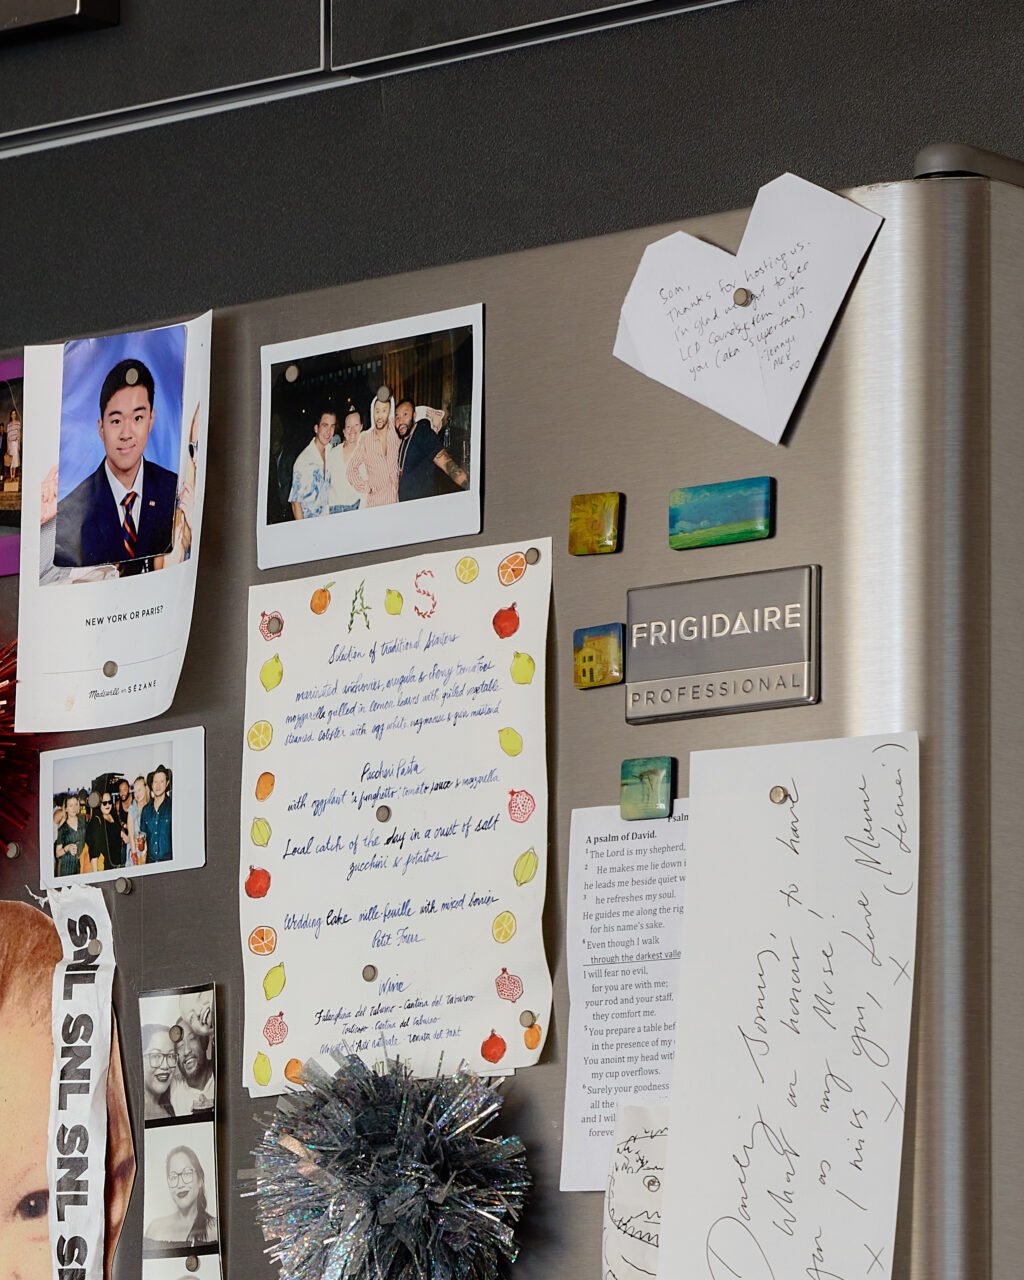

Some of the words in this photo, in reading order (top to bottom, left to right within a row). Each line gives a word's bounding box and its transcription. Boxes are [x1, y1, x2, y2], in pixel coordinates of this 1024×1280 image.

[667, 292, 712, 322] Thanks
[718, 279, 737, 294] for
[745, 253, 788, 282] hosting
[694, 308, 719, 336] glad
[750, 285, 766, 311] got
[774, 276, 786, 288] to
[348, 578, 372, 633] A
[414, 569, 437, 619] S
[85, 617, 104, 626] NEW
[107, 613, 127, 623] YORK
[130, 611, 140, 620] OR
[142, 605, 164, 618] PARIS?
[631, 603, 801, 648] FRIGIDAIRE
[631, 673, 801, 709] PROFESSIONAL
[287, 792, 308, 811] with
[283, 836, 314, 860] Local
[316, 834, 345, 853] catch
[349, 834, 359, 855] of
[363, 828, 380, 848] the
[384, 826, 406, 850] day
[410, 828, 420, 841] in
[434, 819, 460, 839] crust
[462, 816, 473, 838] of
[475, 813, 500, 832] salt
[586, 836, 592, 844] A
[593, 833, 619, 845] psalm
[621, 832, 630, 841] of
[631, 830, 657, 841] David.
[590, 850, 605, 859] The
[606, 848, 625, 858] Lord
[626, 847, 633, 856] is
[635, 847, 647, 857] my
[648, 843, 686, 856] shepherd,
[346, 853, 388, 881] zucchini
[402, 848, 448, 876] potatoes
[597, 865, 608, 874] He
[609, 863, 635, 873] makes
[636, 863, 649, 871] me
[650, 861, 660, 870] lie
[660, 859, 682, 869] down
[584, 881, 594, 890] he
[595, 879, 616, 889] leads
[617, 879, 630, 887] me
[631, 875, 657, 886] beside
[658, 874, 677, 886] quiet
[595, 895, 605, 905] he
[606, 892, 644, 904] refreshes
[645, 893, 657, 902] my
[658, 890, 676, 899] soul.
[779, 883, 802, 907] to
[583, 911, 593, 920] He
[594, 909, 621, 921] guides
[622, 909, 635, 917] me
[636, 906, 657, 918] along
[658, 905, 671, 914] the
[284, 913, 323, 939] Wedding
[590, 925, 602, 934] for
[603, 924, 615, 933] his
[616, 922, 644, 931] name's
[645, 920, 665, 929] sake.
[63, 912, 101, 1001] SNL
[378, 974, 411, 996] Wine
[611, 1009, 641, 1019] comfort
[58, 1014, 95, 1110] SNL
[621, 1067, 661, 1077] overflows.
[587, 1085, 613, 1095] Surely
[614, 1085, 632, 1094] your
[633, 1083, 669, 1093] goodness
[820, 1058, 853, 1113] my
[55, 1124, 89, 1222] SNL
